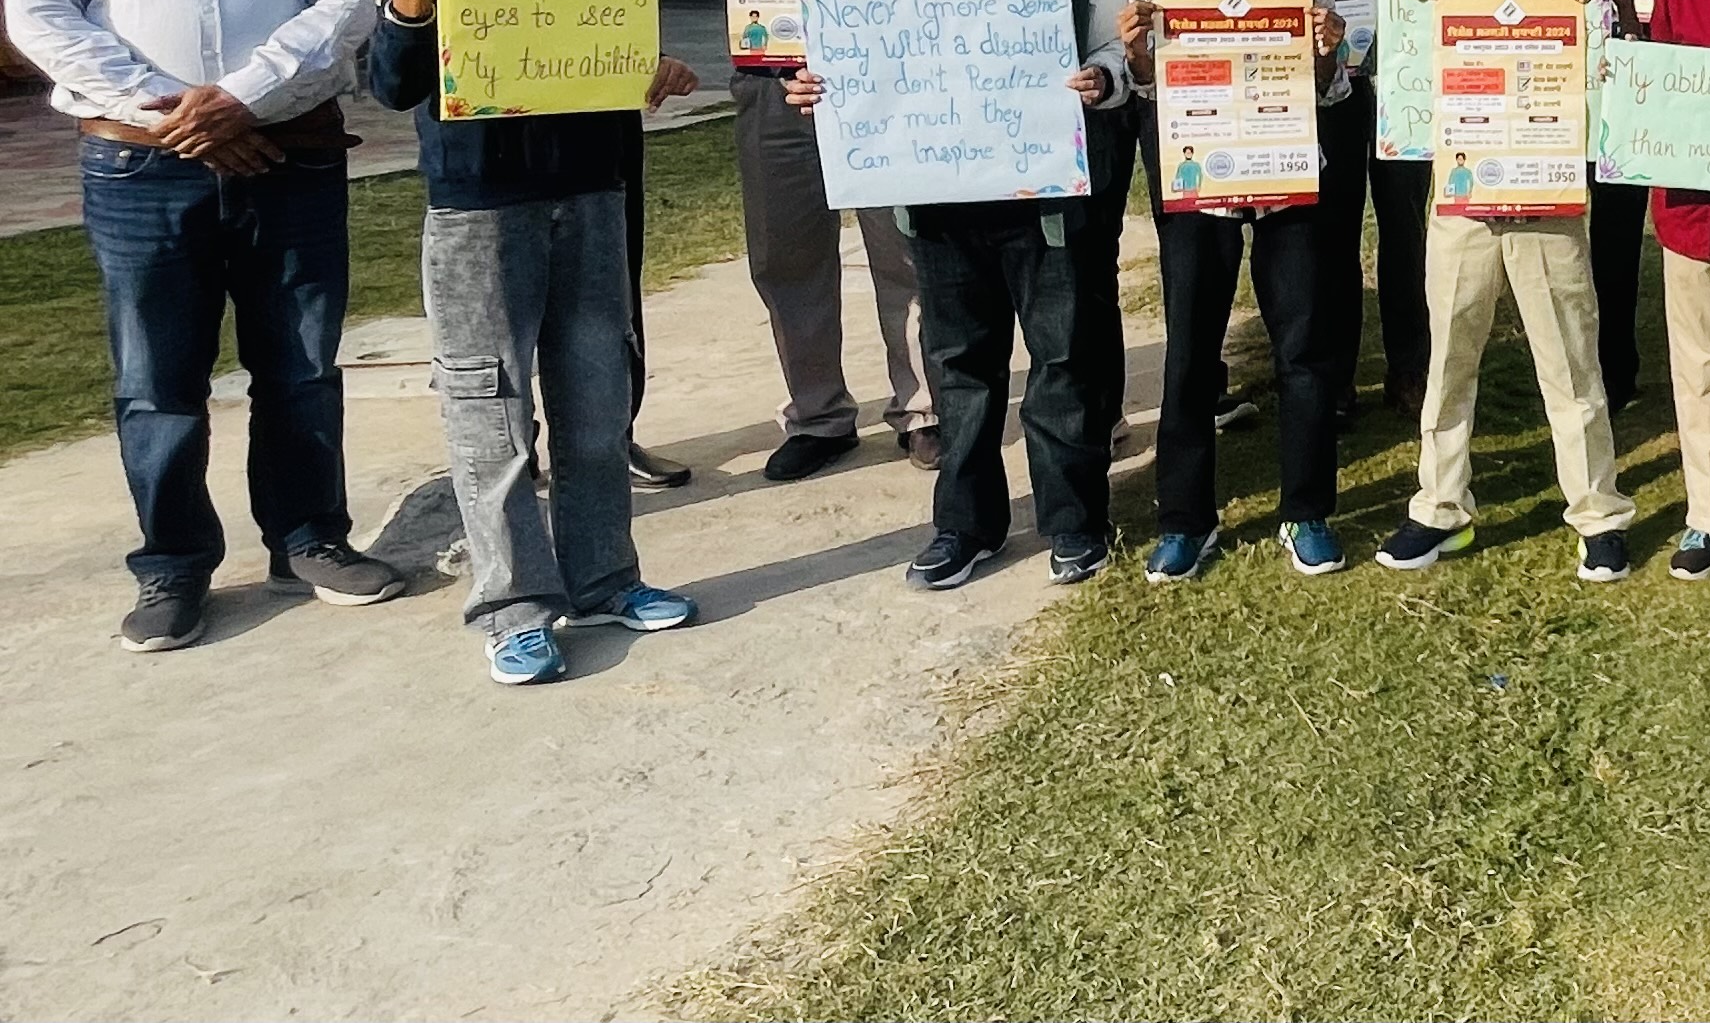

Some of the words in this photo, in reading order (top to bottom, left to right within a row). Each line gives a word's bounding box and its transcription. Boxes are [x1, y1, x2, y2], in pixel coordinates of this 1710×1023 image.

[460, 7, 519, 41] eyes
[531, 2, 555, 27] to
[577, 5, 626, 27] see
[1273, 18, 1299, 29] 2024
[1545, 26, 1571, 37] 2024
[820, 32, 870, 76] body
[954, 35, 971, 56] a
[980, 22, 1075, 69] disability
[1393, 32, 1418, 57] is
[456, 50, 504, 98] My
[515, 45, 573, 80] true
[579, 43, 657, 78] abilities
[826, 76, 877, 108] you
[965, 63, 1048, 92] Realize
[1614, 56, 1654, 104] My
[904, 96, 961, 129] much
[981, 98, 1023, 138] they
[847, 147, 890, 171] Can
[1011, 141, 1054, 174] you
[1629, 128, 1675, 158] than
[1279, 161, 1309, 173] 1950
[1547, 171, 1576, 183] 1950
